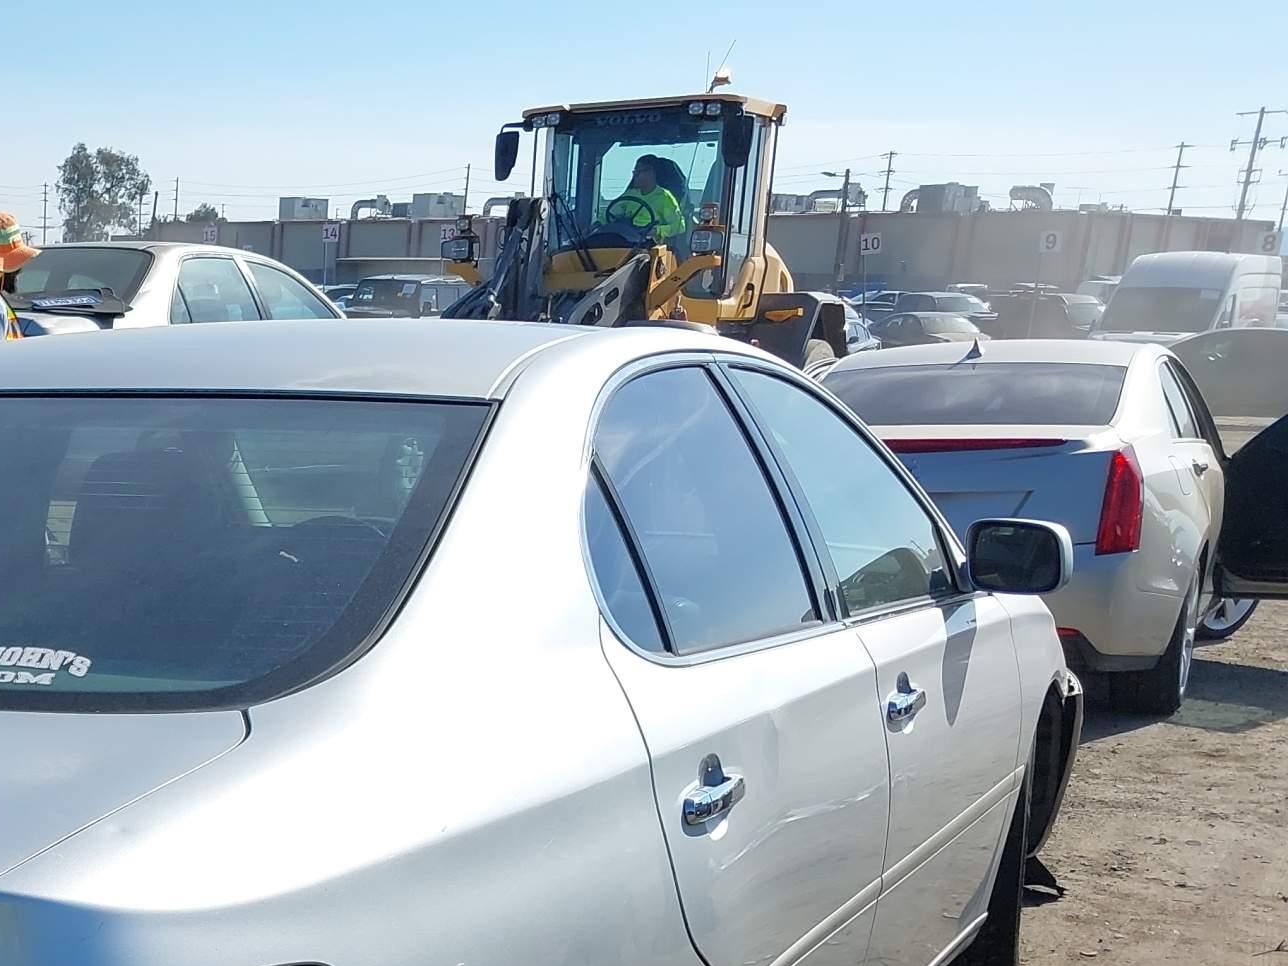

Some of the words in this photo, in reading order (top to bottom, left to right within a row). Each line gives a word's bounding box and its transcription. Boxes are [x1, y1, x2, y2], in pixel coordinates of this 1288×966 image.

[596, 111, 661, 126] VOLVO
[203, 229, 216, 242] 15
[323, 227, 337, 240] 14
[441, 228, 455, 240] 13
[861, 236, 881, 251] 10
[1045, 233, 1057, 250] 9
[1261, 234, 1276, 252] 8
